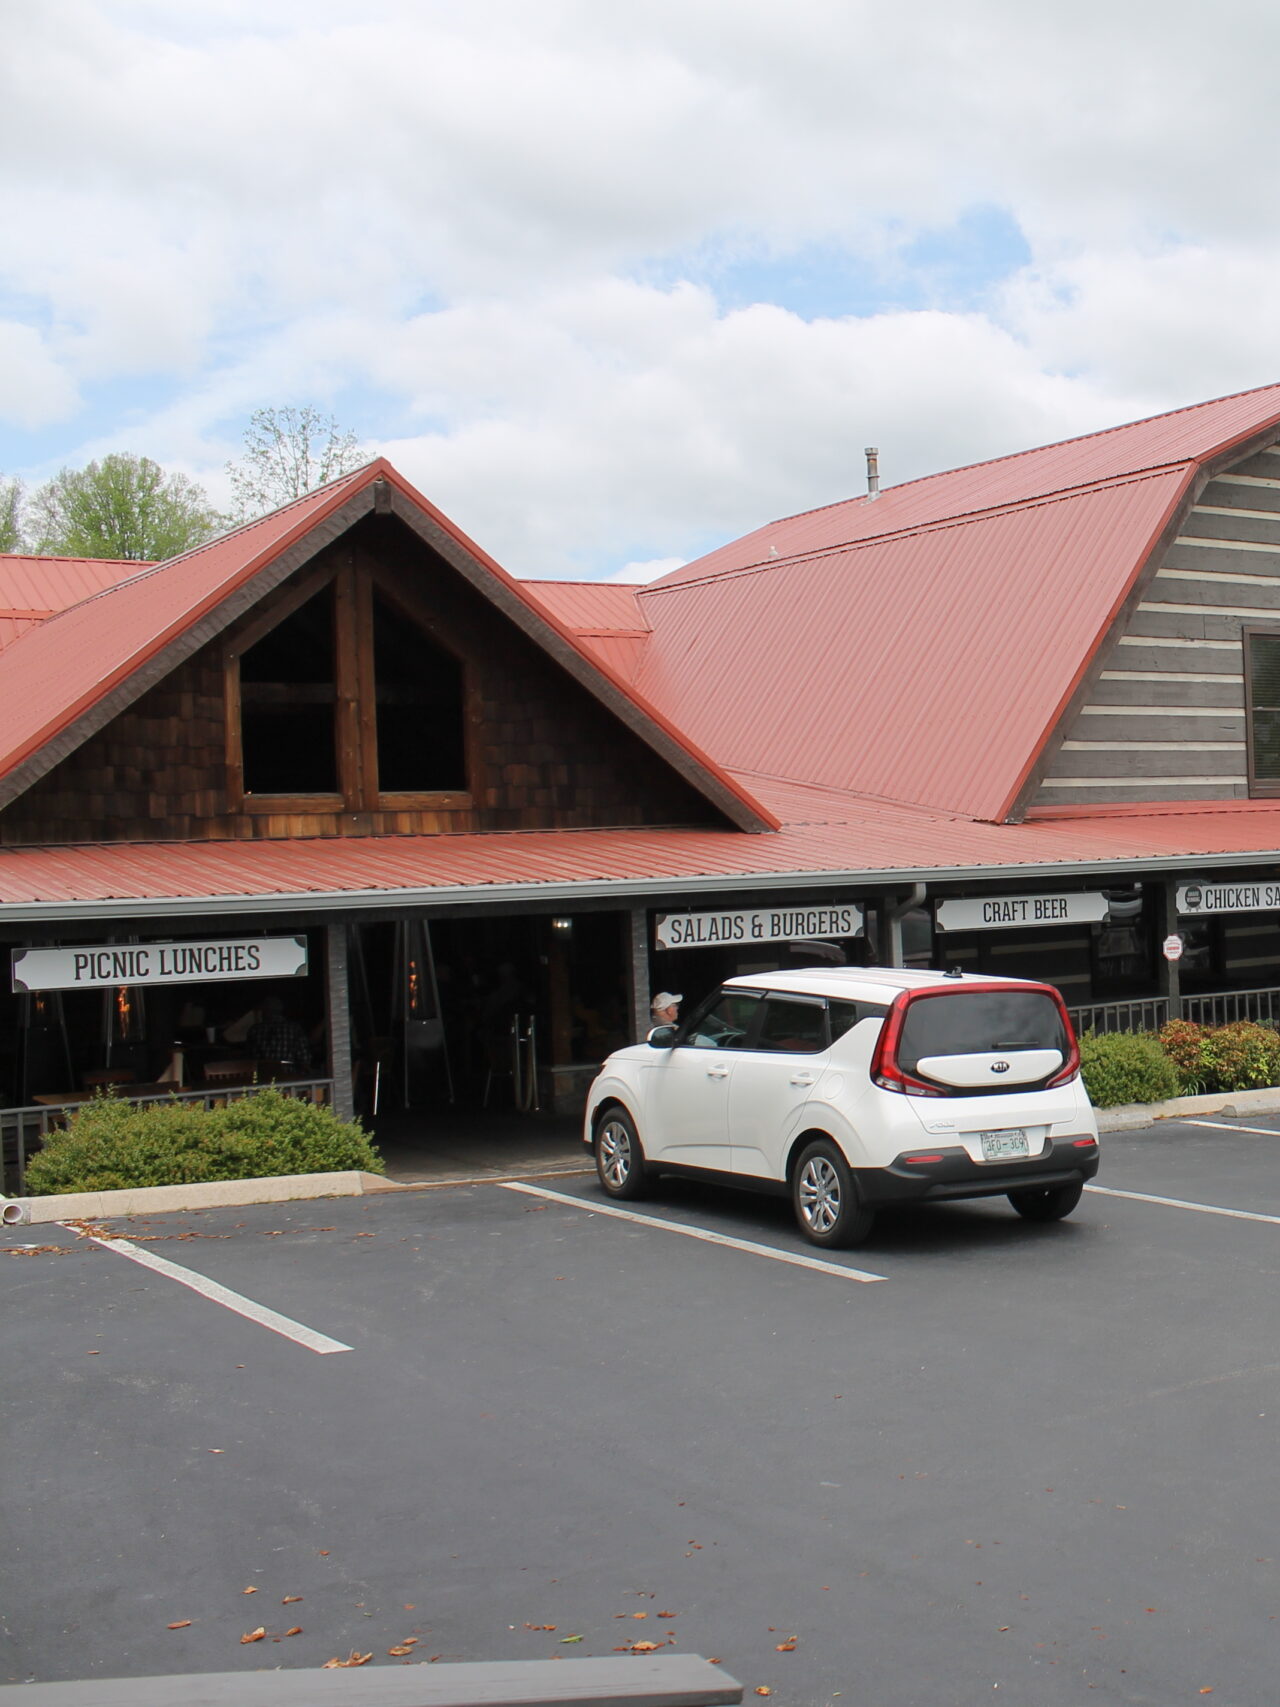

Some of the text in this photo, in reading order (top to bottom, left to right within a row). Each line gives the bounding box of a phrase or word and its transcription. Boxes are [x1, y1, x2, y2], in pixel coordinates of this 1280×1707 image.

[983, 898, 1068, 923] CRAFT BEER
[1205, 887, 1260, 909] CHICKEN
[670, 909, 851, 944] SALADS & BURGERS
[74, 944, 260, 981] PICNIC LUNCHES
[992, 1062, 1009, 1072] KIA
